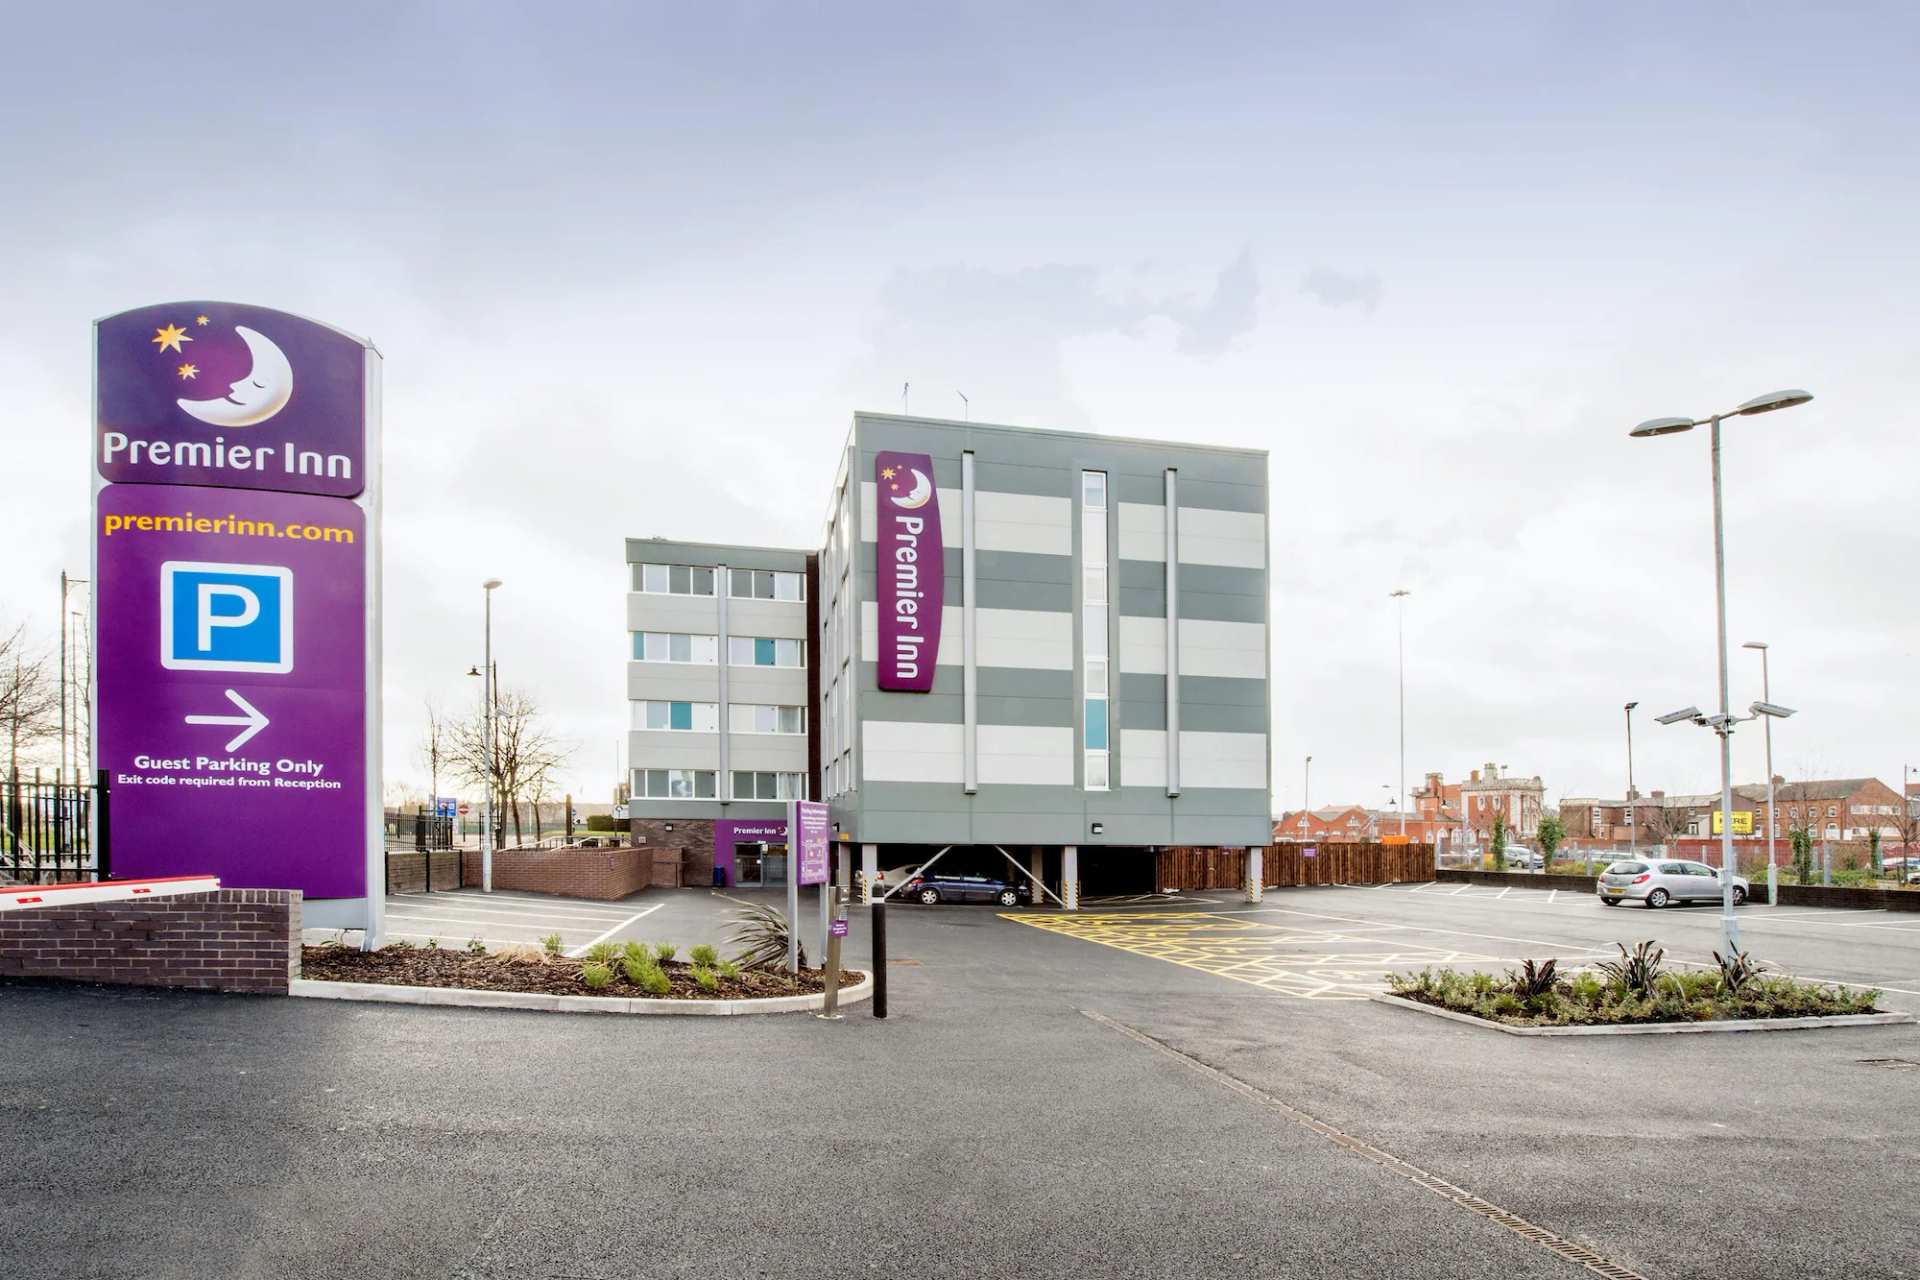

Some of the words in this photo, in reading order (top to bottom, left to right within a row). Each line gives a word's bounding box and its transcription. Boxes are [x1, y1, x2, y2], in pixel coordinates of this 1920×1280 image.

[103, 432, 274, 470] Premier
[285, 442, 351, 479] Inn
[104, 511, 354, 544] premierinn.com
[895, 516, 924, 630] Premier
[198, 584, 260, 651] P
[896, 636, 924, 678] Inn
[117, 774, 143, 785] Exit
[145, 774, 177, 785] code
[179, 775, 235, 788] required
[238, 776, 271, 788] from
[274, 777, 341, 791] Reception
[134, 755, 190, 770] Guest
[196, 756, 271, 775] Parking
[276, 758, 324, 777] Only
[733, 826, 763, 834] Premier
